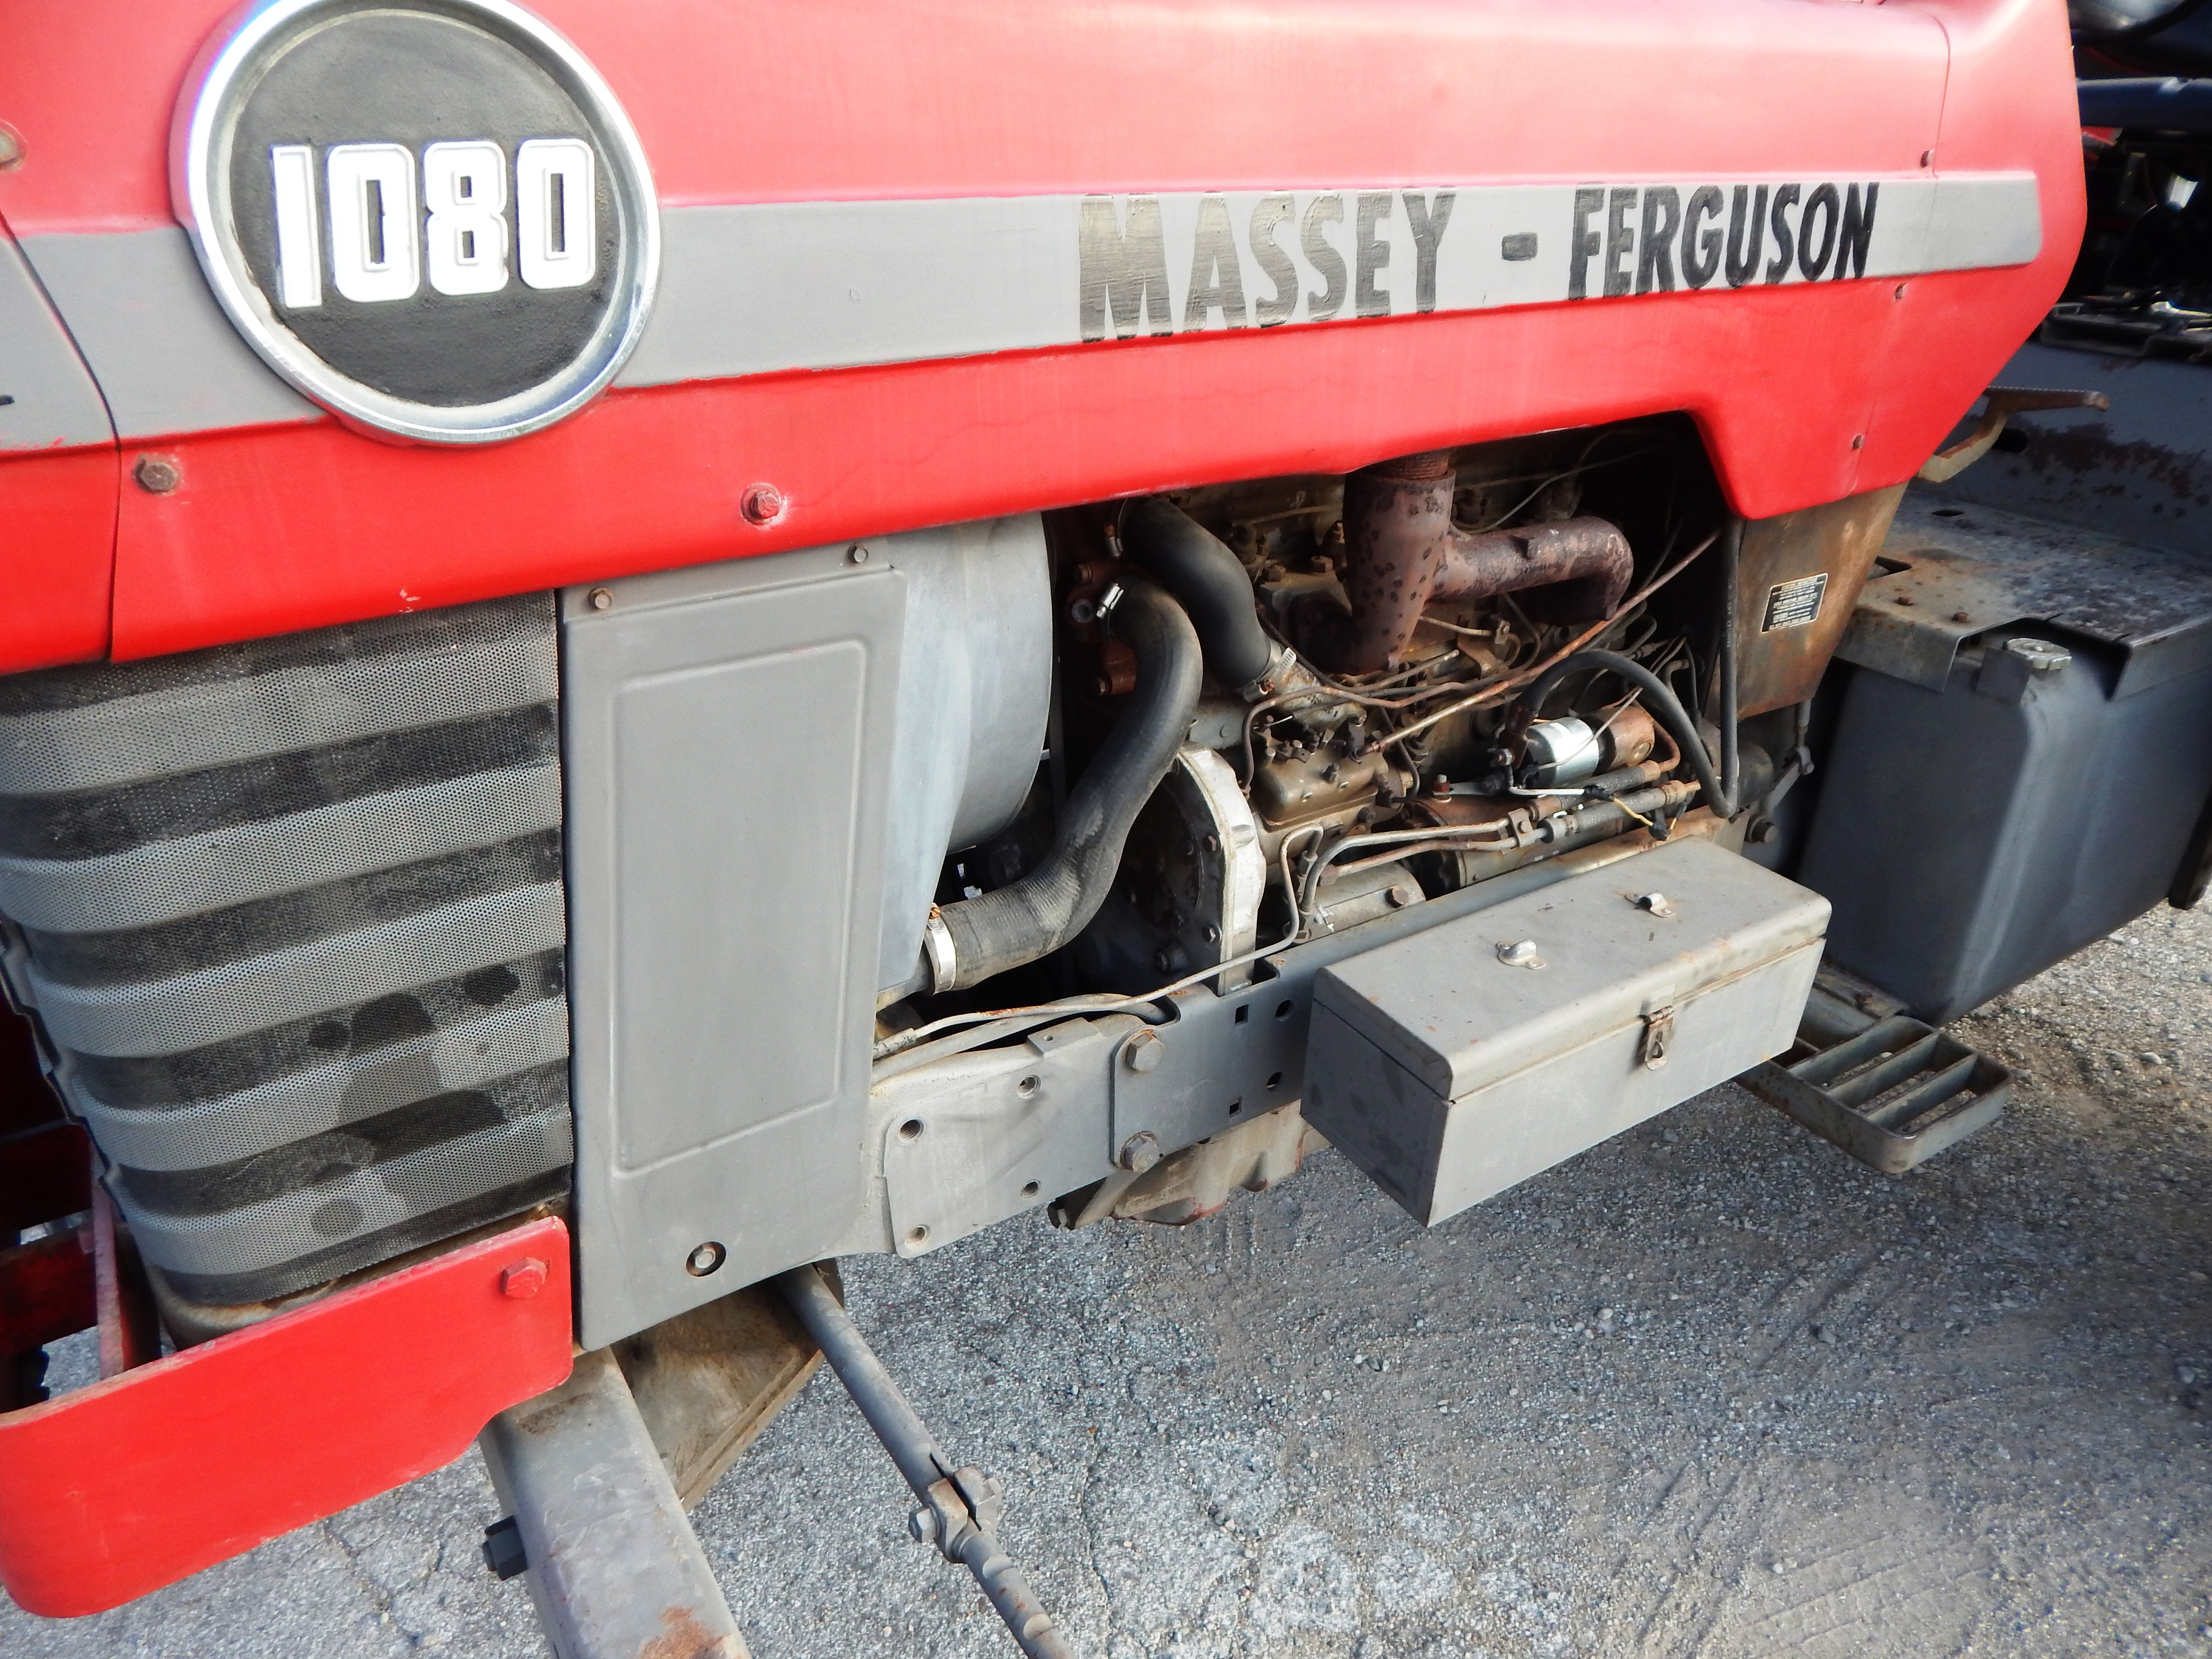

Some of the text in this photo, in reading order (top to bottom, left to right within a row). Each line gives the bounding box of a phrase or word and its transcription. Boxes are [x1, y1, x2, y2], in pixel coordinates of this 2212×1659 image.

[271, 138, 597, 308] 1080
[1080, 185, 1457, 343] MASSEY
[1569, 181, 1880, 301] FERGUSON
